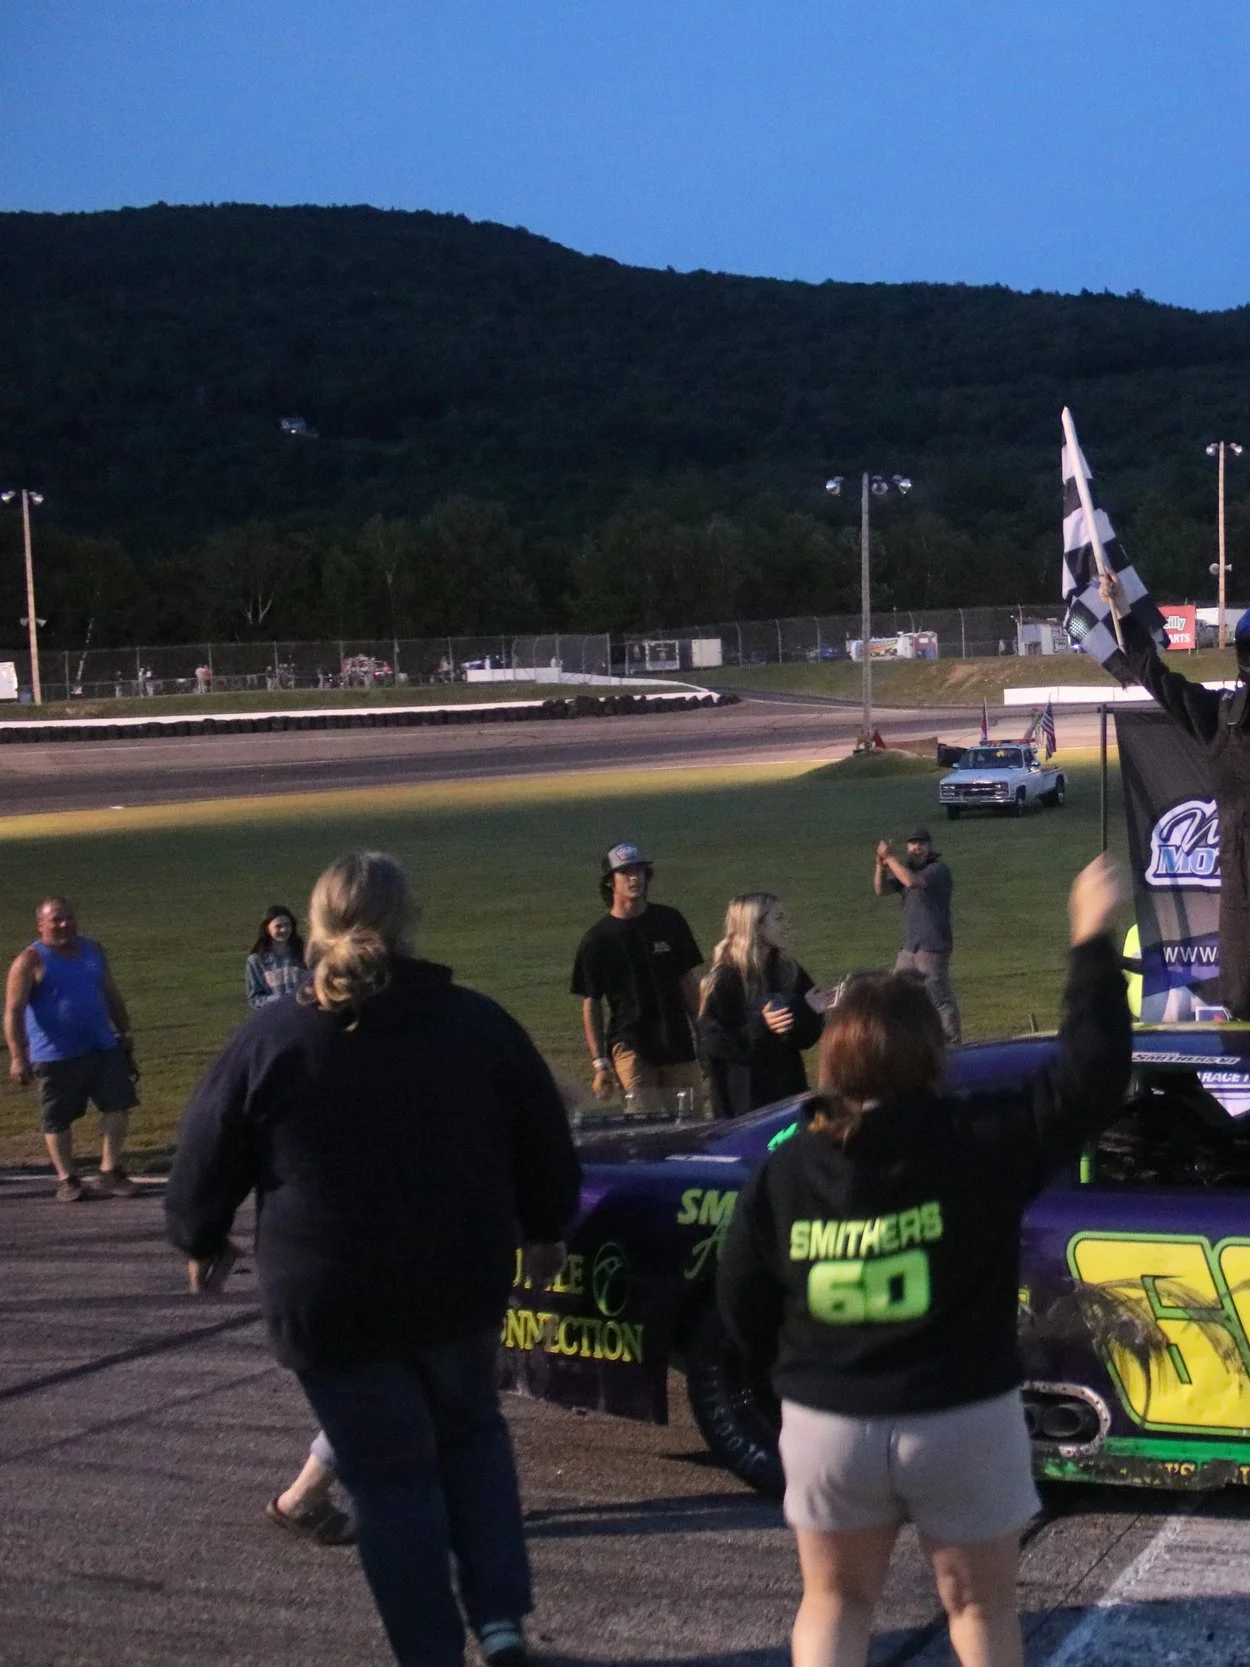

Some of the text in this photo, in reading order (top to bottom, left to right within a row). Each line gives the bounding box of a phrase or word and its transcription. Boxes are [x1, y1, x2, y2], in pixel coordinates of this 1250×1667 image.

[1169, 634, 1191, 644] ARTS
[789, 1201, 944, 1262] SMITHERS
[807, 1248, 930, 1326] 60
